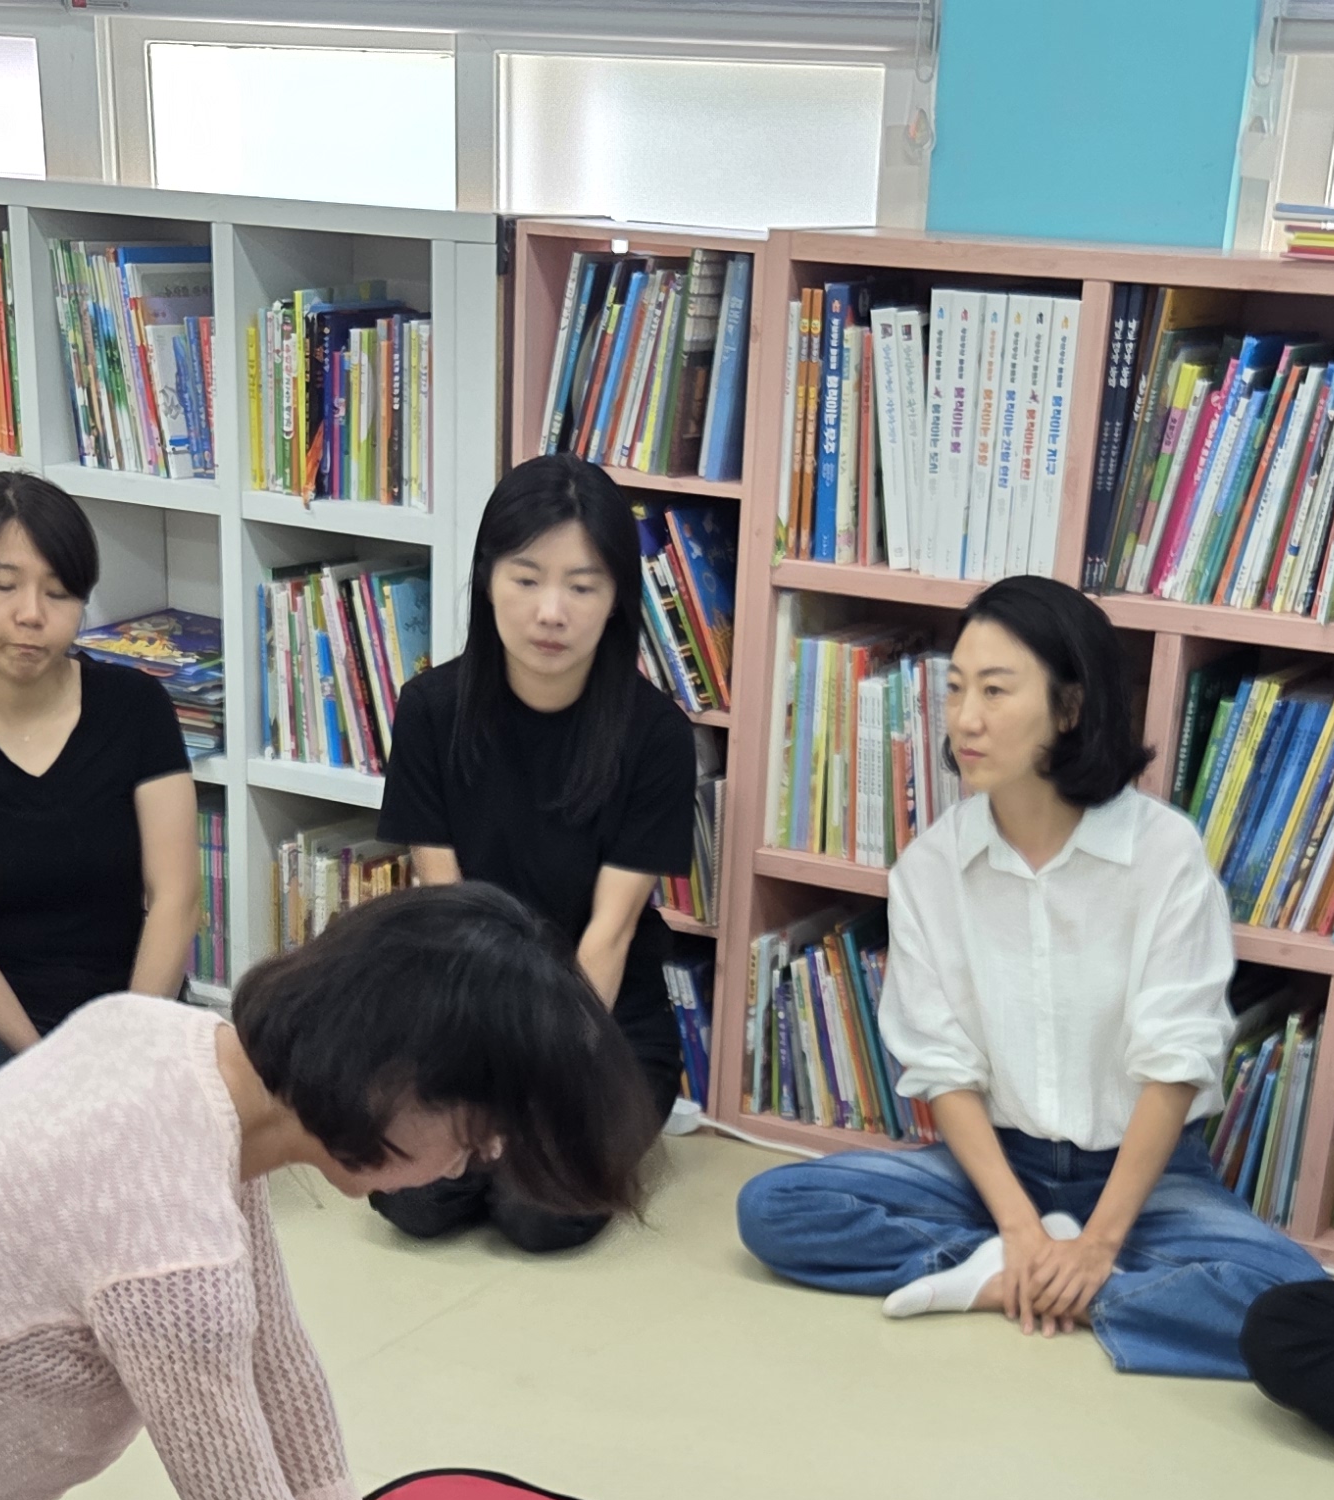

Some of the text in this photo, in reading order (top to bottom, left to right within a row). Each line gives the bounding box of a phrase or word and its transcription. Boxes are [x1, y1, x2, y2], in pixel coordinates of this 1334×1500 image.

[825, 375, 840, 426] 움직이는
[951, 387, 965, 437] 움직이는
[979, 388, 994, 437] 움직이는
[1002, 390, 1017, 437] 움직이는
[1047, 395, 1064, 445] 움직이는
[823, 427, 837, 454] 우주
[930, 404, 942, 448] 움직이는
[1023, 408, 1037, 455] 움직이는
[1045, 448, 1059, 475] 지구
